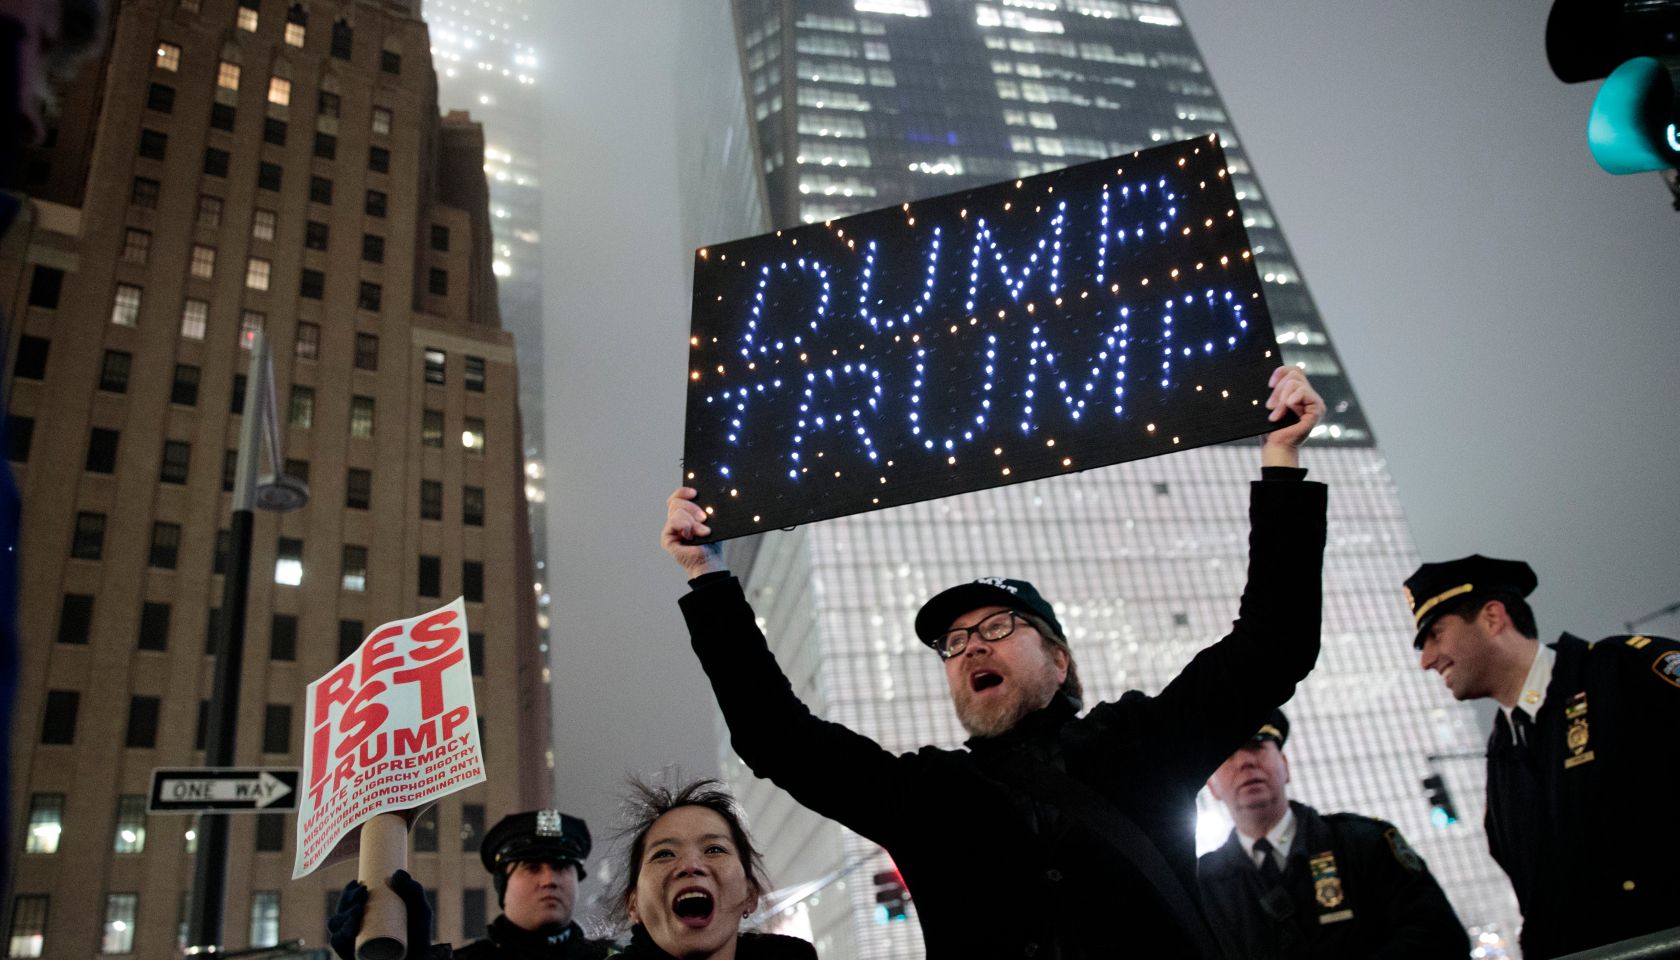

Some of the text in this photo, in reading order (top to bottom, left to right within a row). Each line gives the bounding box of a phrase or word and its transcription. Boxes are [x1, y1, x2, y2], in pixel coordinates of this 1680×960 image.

[740, 175, 1180, 359] DUMP
[706, 287, 1249, 481] TRUMP
[309, 648, 464, 790] IST
[314, 610, 462, 728] RES
[173, 781, 278, 799] ONE WAY
[303, 732, 470, 833] WHITE SUPREMACY
[303, 745, 475, 847] MISOGYNY OLIGARCHY BIGOTRY
[303, 756, 479, 859] XENOPHOBIA HOMOPHOBIA ANTI
[308, 705, 470, 811] TRUMP
[303, 767, 481, 870] SEMITISM GENDER DISCRIMINATION
